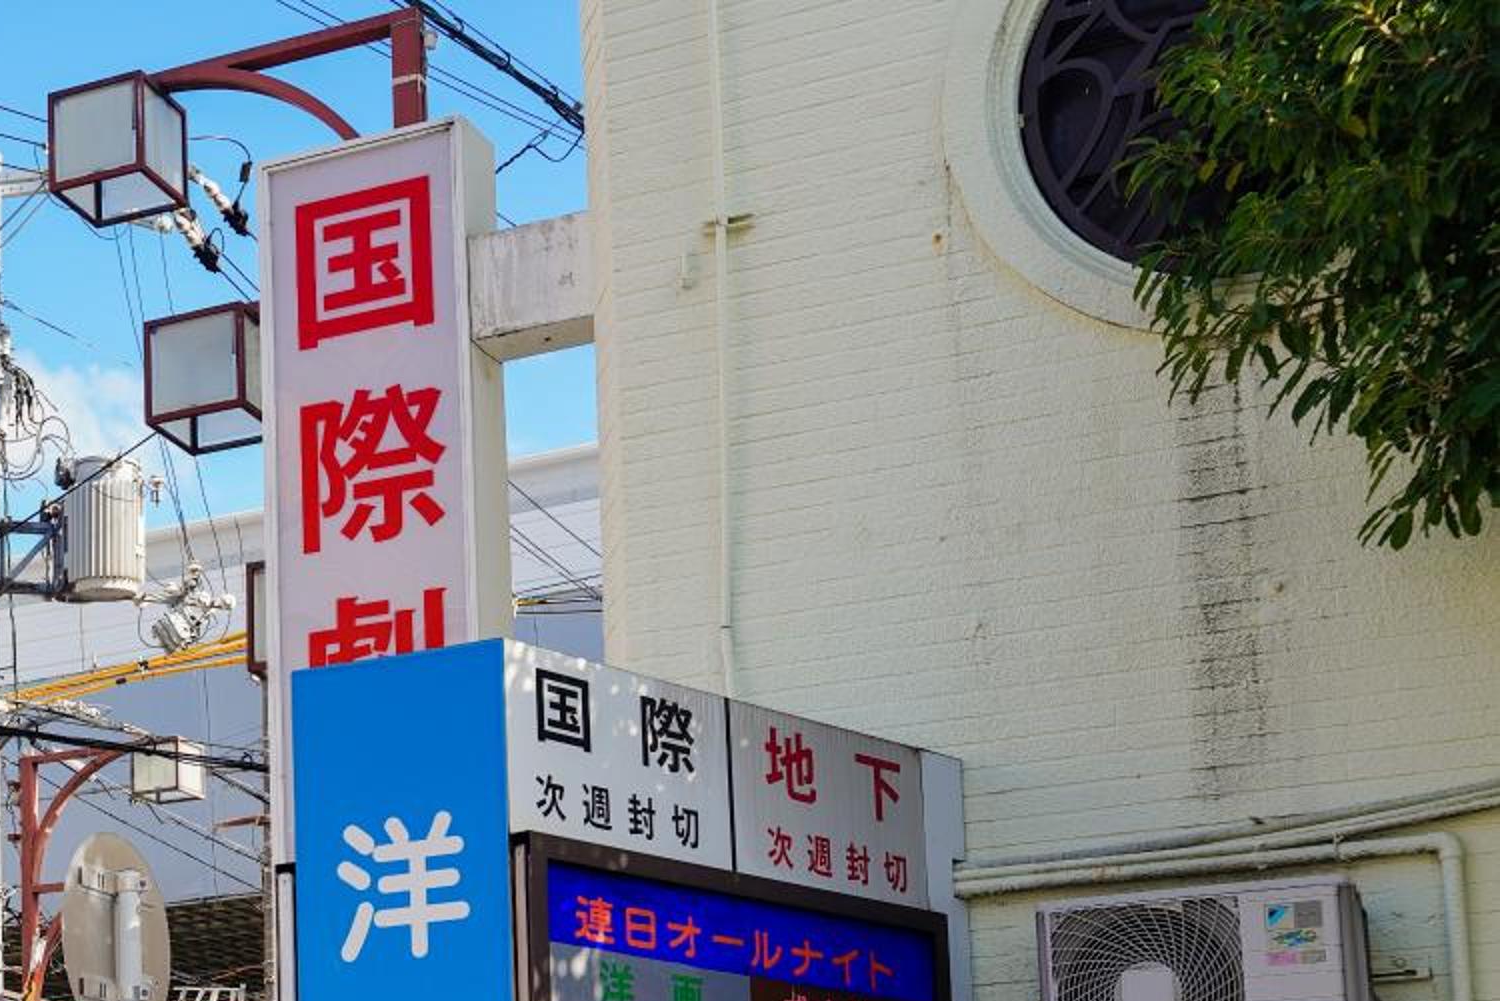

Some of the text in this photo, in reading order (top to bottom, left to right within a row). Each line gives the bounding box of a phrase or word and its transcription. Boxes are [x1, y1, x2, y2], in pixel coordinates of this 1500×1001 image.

[536, 668, 696, 774] 国際
[534, 774, 700, 850] 次週封切
[764, 726, 902, 822] 地下
[767, 827, 908, 894] 次週封切
[575, 894, 894, 992] 連日オールナイト
